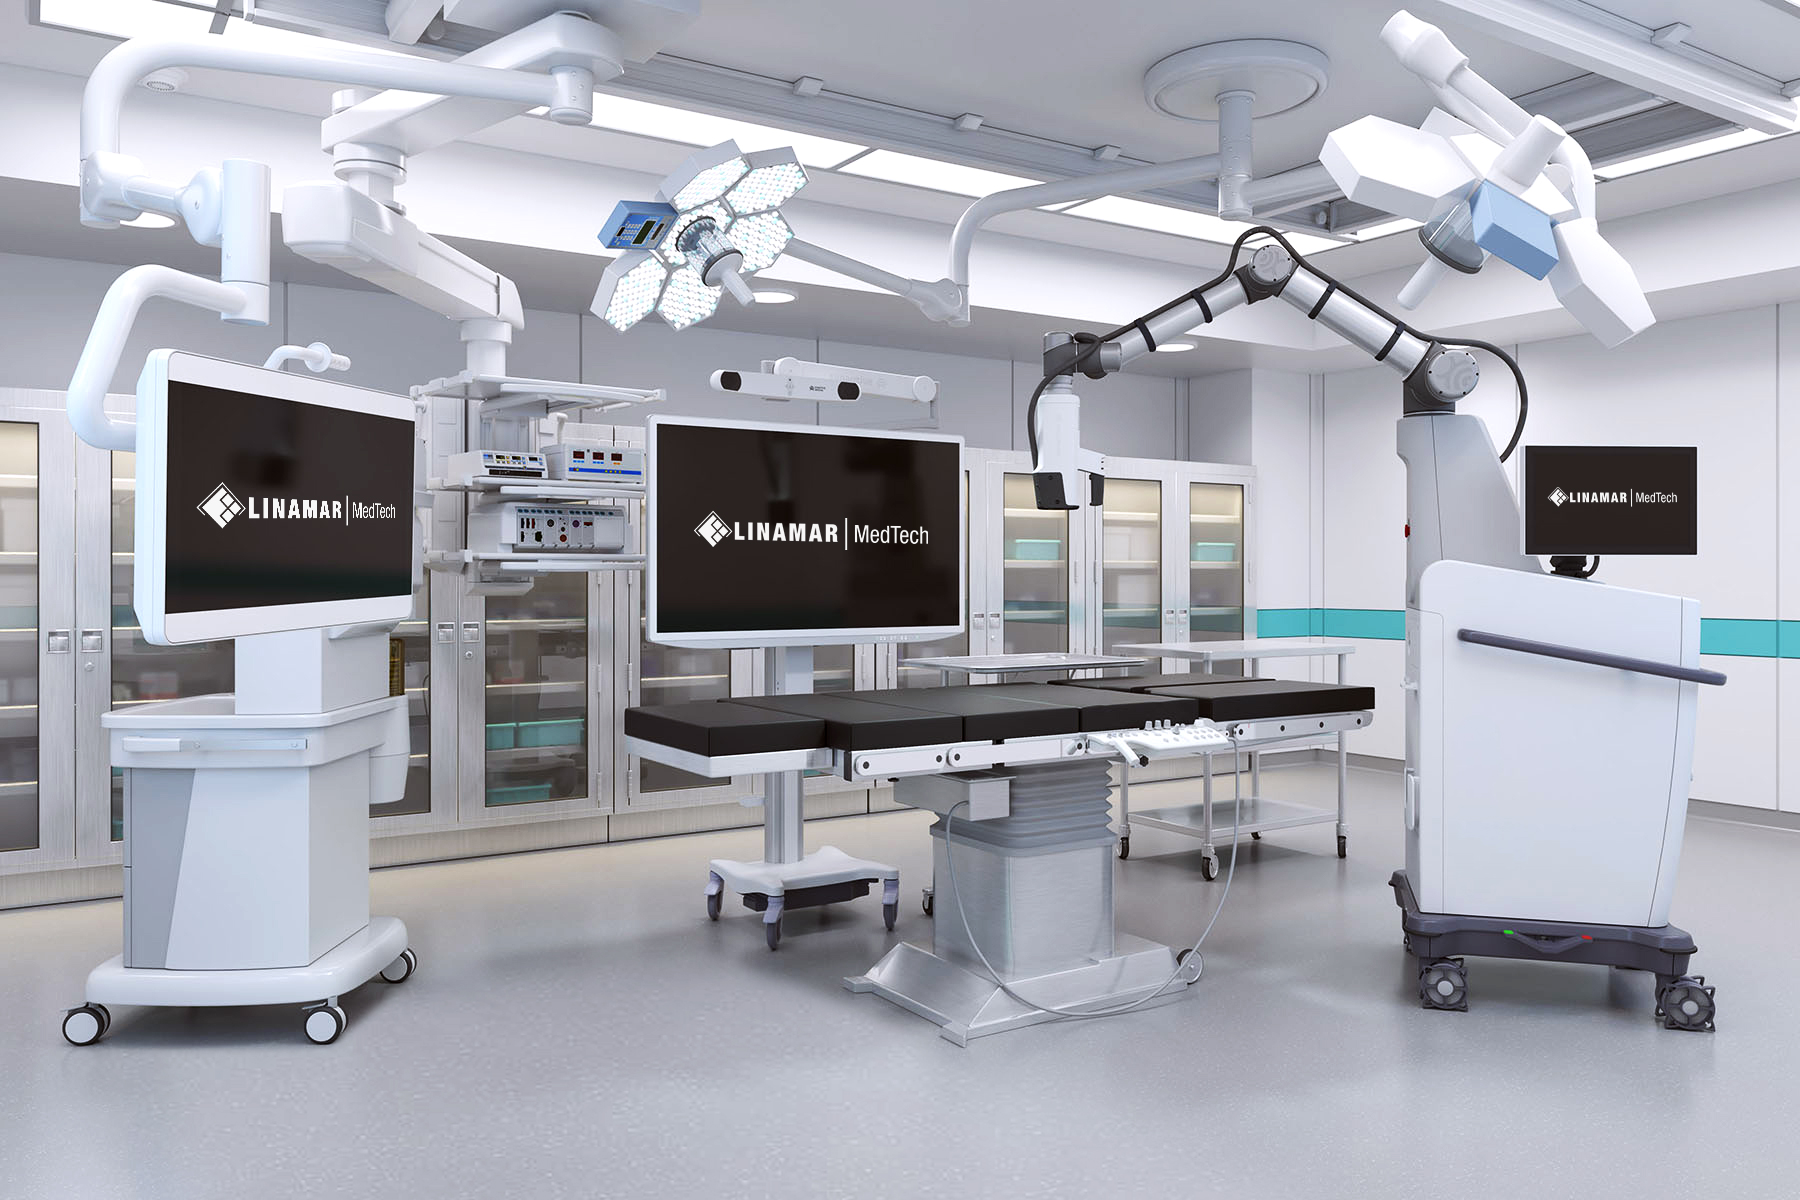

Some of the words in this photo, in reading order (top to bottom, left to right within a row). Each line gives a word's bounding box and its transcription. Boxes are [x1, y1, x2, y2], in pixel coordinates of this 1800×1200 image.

[248, 497, 342, 519] LINAMAR
[352, 501, 396, 519] MedTech
[1569, 492, 1628, 503] LINAMAR
[1635, 492, 1678, 503] MedTech
[734, 521, 838, 543] LINAMAR
[854, 524, 929, 545] MedTech
